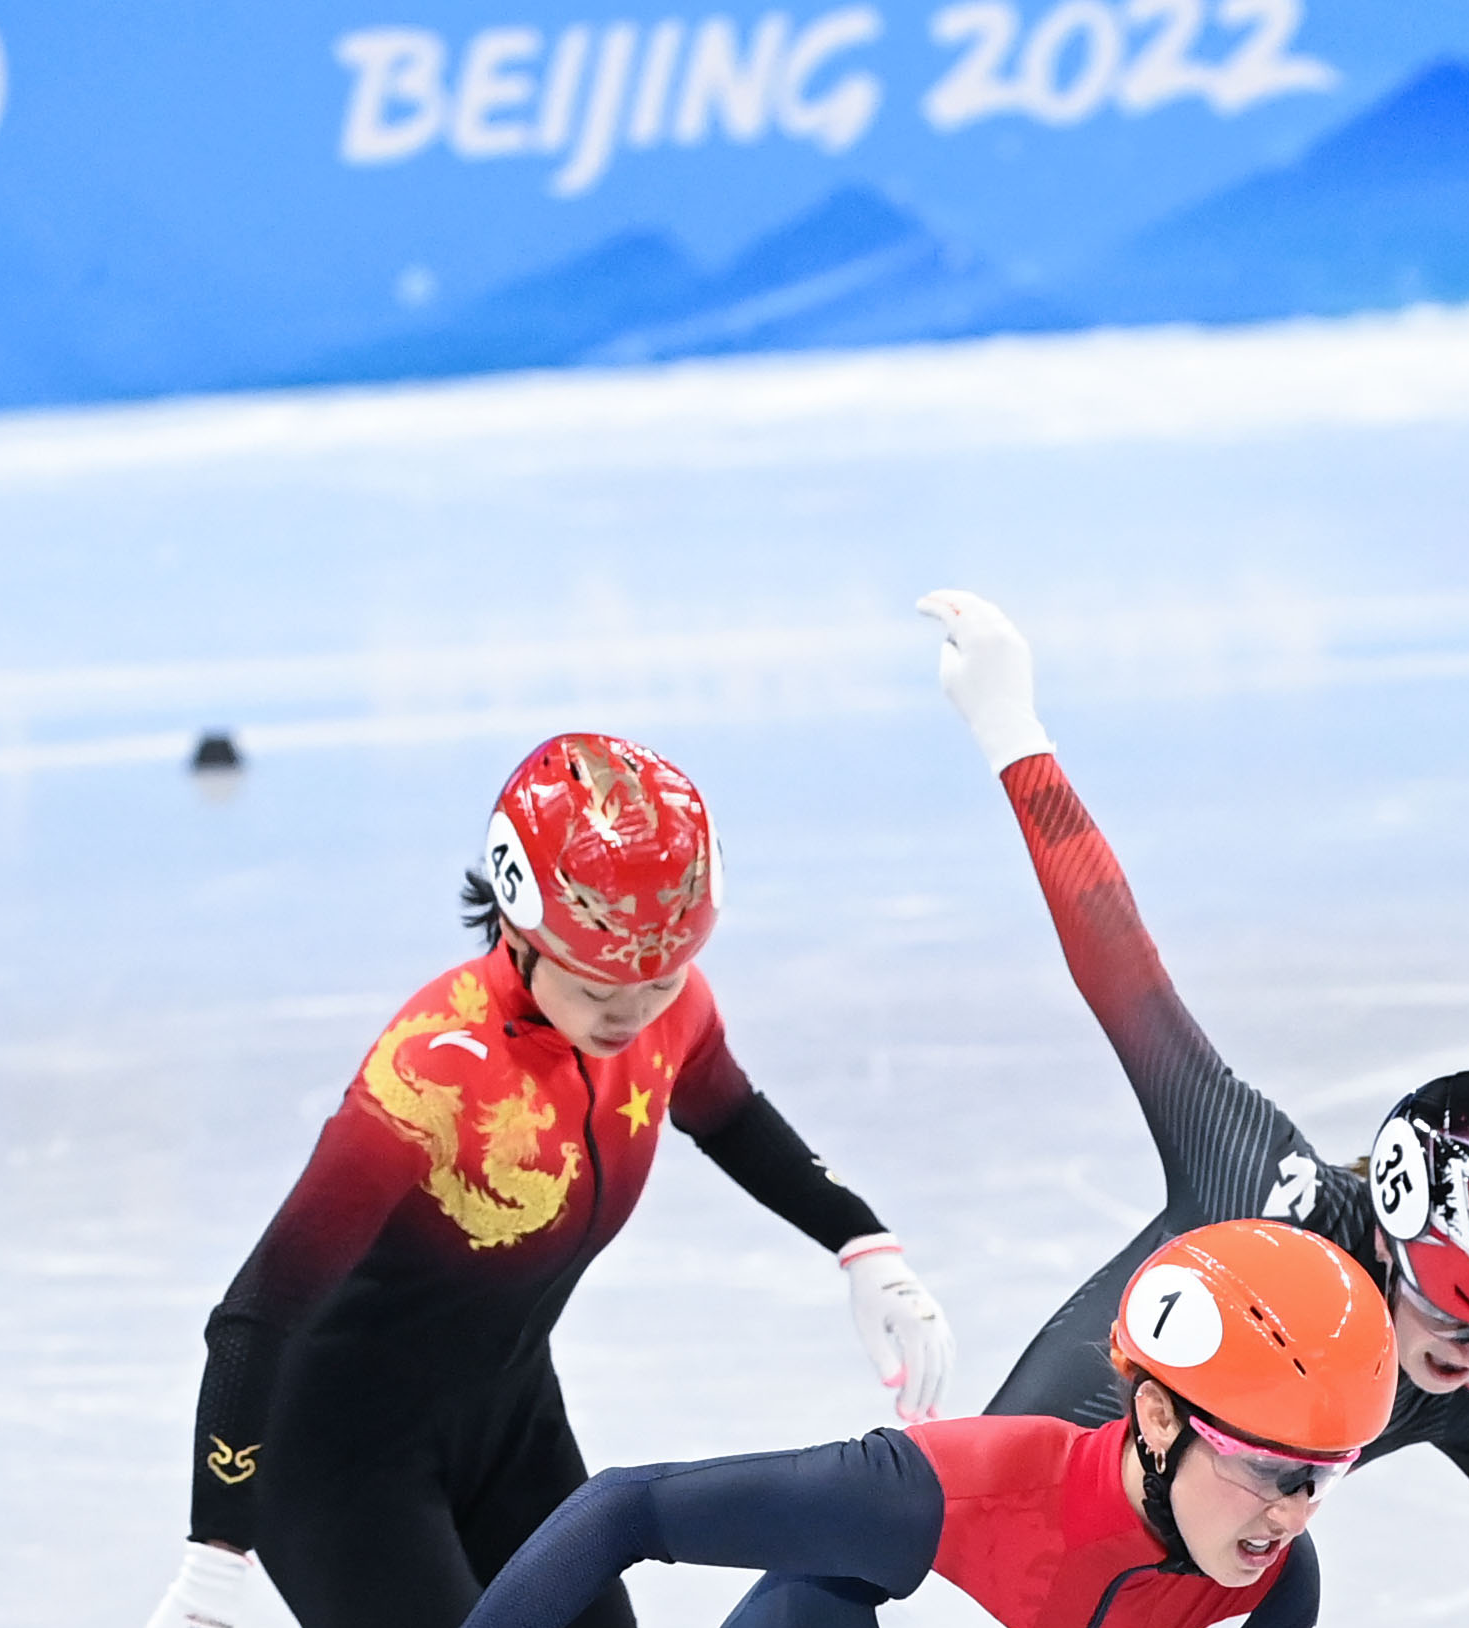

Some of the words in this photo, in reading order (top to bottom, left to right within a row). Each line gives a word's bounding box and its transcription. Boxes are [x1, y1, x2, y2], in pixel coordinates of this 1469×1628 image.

[336, 8, 882, 197] BEIJING
[925, 0, 1339, 129] 2022
[492, 843, 524, 905] 45
[1375, 1143, 1413, 1215] 35
[1152, 1290, 1183, 1340] 1
